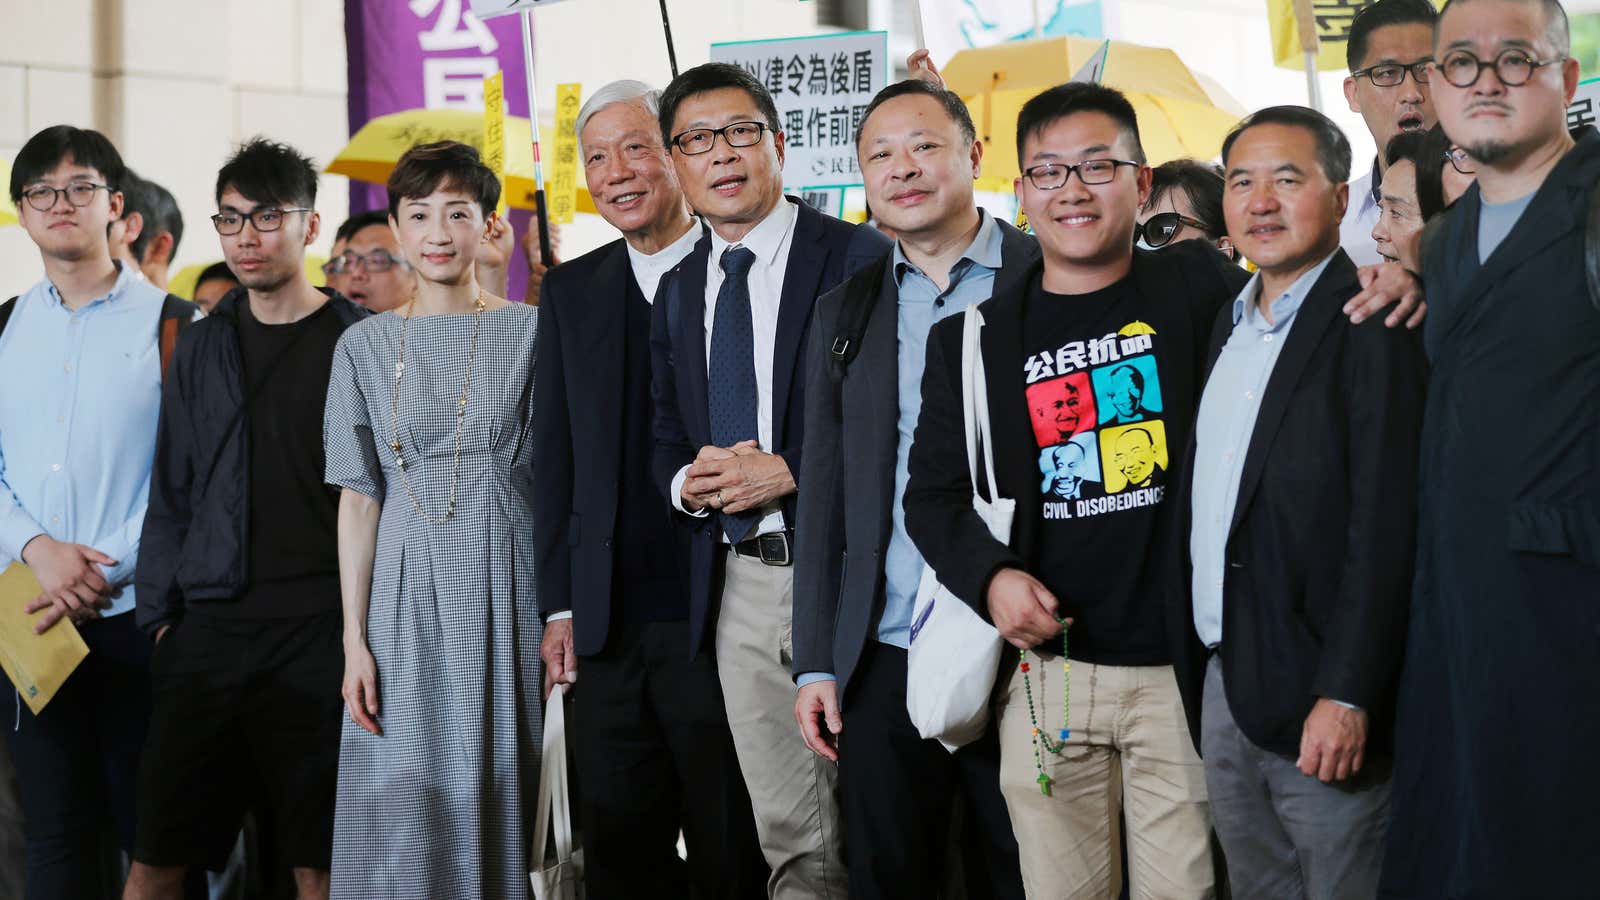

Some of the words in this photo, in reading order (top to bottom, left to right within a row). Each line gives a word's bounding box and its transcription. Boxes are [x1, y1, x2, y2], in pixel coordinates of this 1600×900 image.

[735, 49, 873, 100] 以律令為後盾
[1024, 321, 1157, 384] 公民抗命
[1043, 501, 1072, 519] CIVIL
[1076, 485, 1166, 517] DISOBEDIENCE
